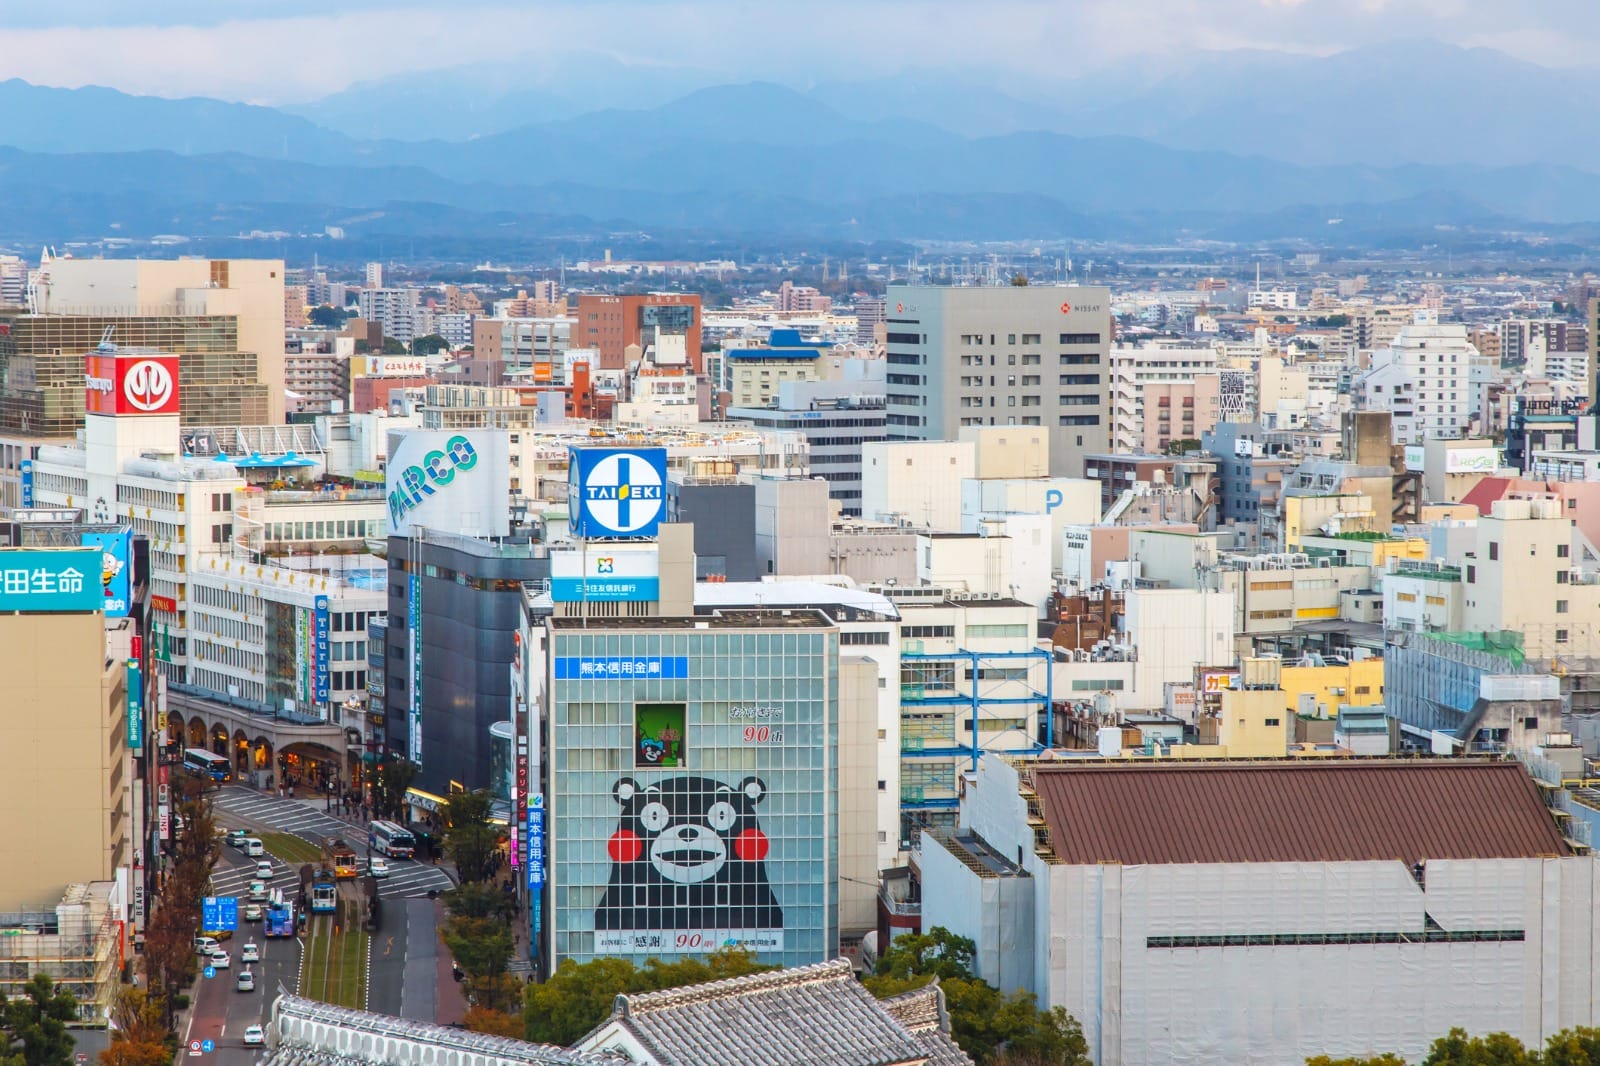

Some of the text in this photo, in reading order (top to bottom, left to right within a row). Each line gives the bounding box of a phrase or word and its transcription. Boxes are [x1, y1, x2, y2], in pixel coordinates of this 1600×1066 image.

[388, 436, 478, 531] PARCO
[1046, 490, 1063, 515] P
[318, 618, 327, 697] Tsuruya
[581, 662, 660, 674] 熊本信用金庫
[743, 726, 769, 742] 90
[529, 811, 541, 884] 熊本信用金庫
[676, 933, 702, 948] 90
